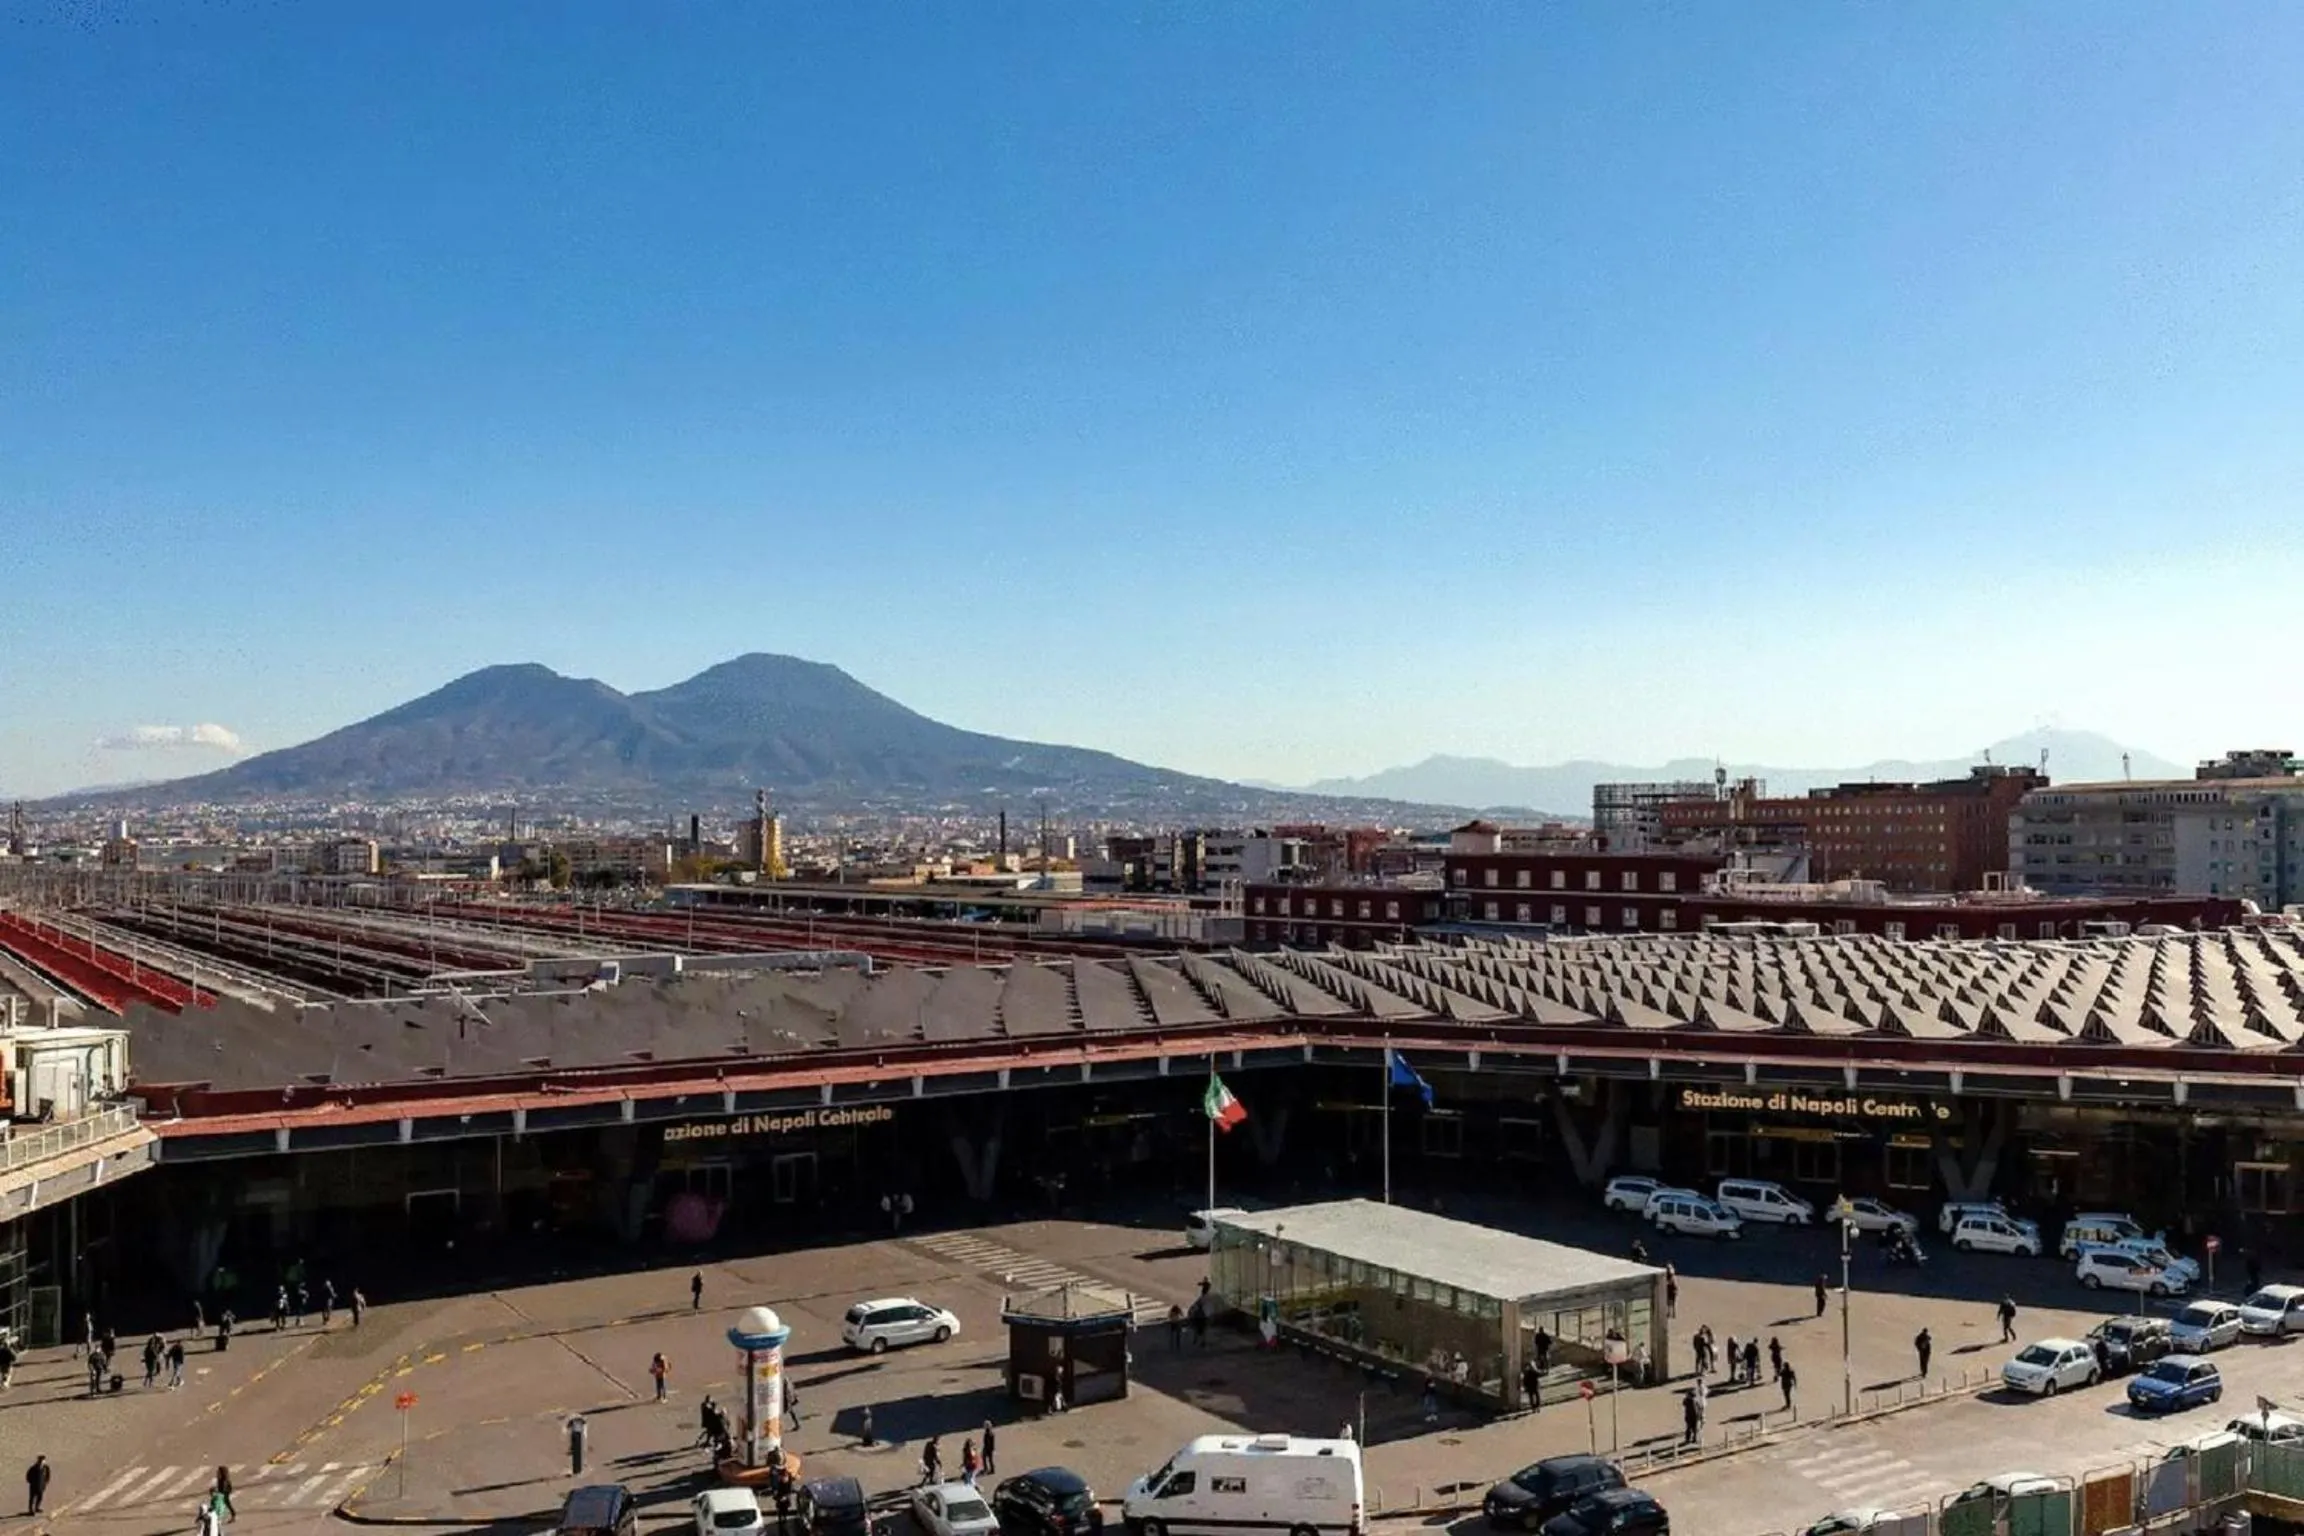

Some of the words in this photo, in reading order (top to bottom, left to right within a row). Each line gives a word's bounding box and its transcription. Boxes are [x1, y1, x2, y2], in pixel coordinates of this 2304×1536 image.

[1682, 1089, 1763, 1109] Stazione
[1767, 1092, 1787, 1110] di
[1791, 1095, 1858, 1116] Napoli
[1863, 1099, 1950, 1119] Centre
[663, 1123, 726, 1141] azione
[731, 1117, 750, 1135] di
[753, 1109, 816, 1133] Napoli
[819, 1105, 893, 1126] Centrale
